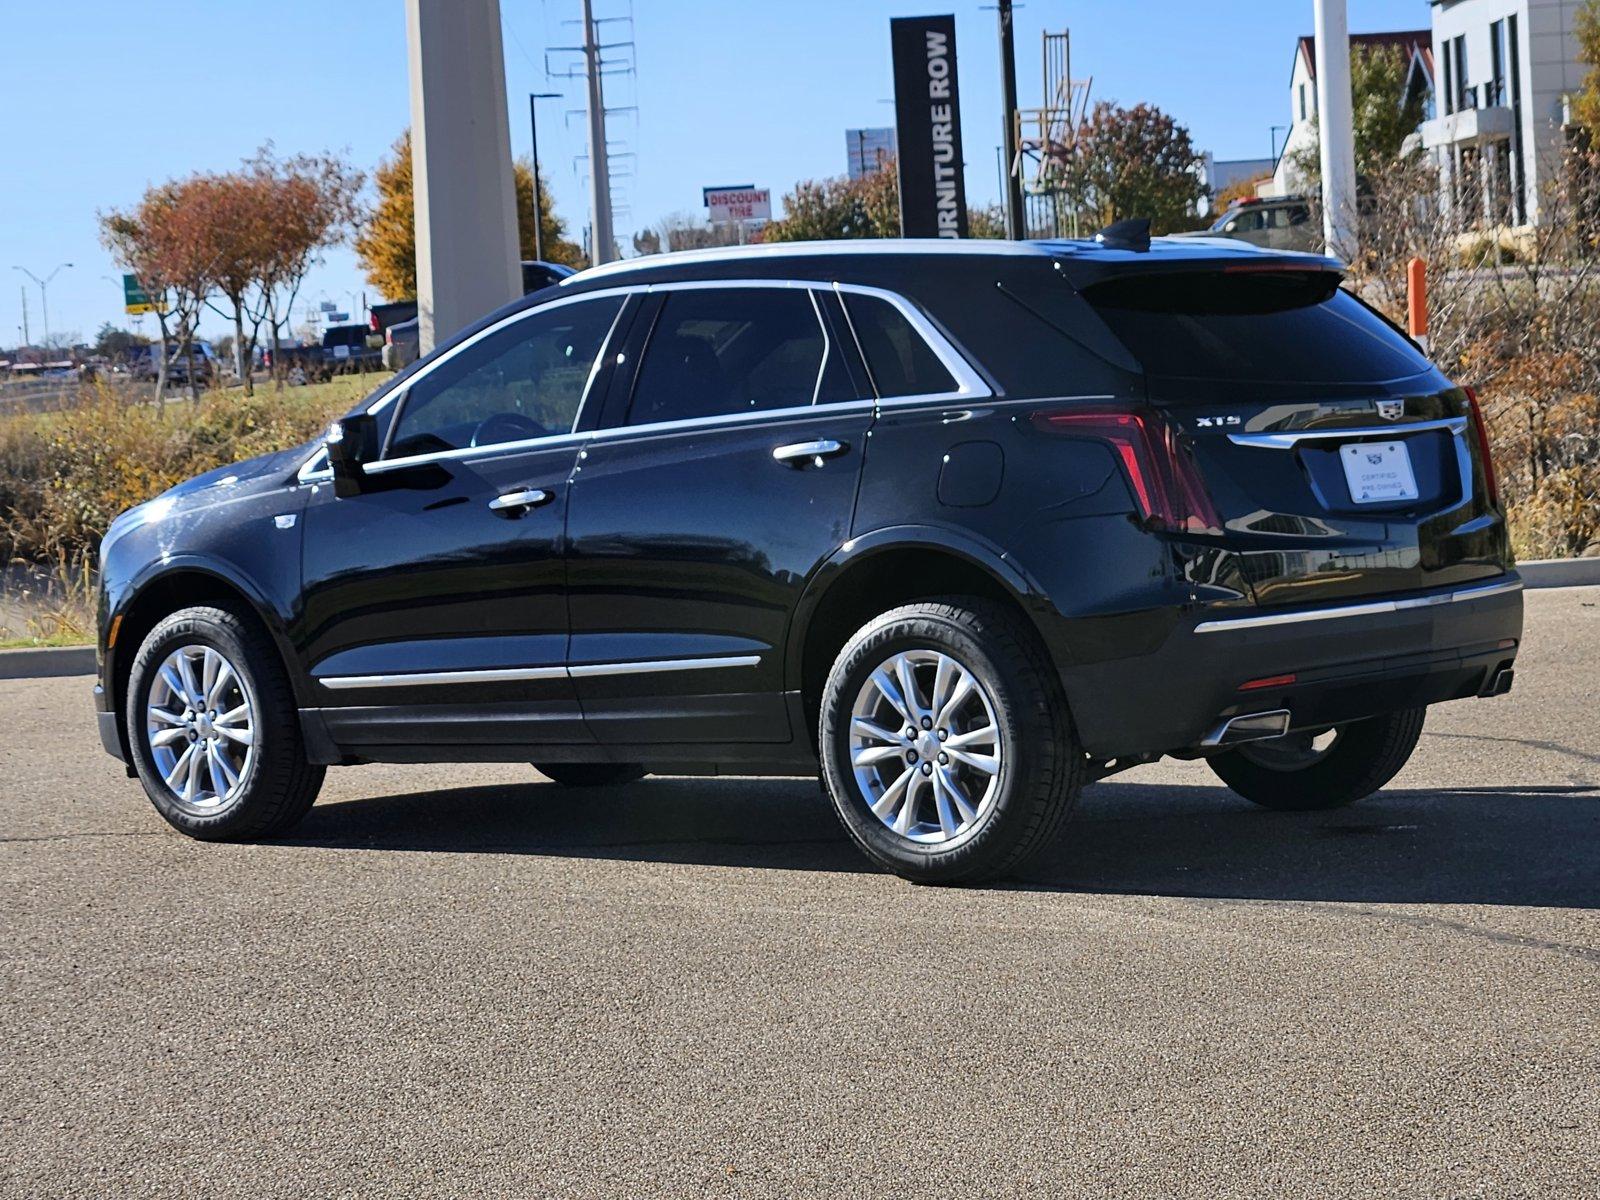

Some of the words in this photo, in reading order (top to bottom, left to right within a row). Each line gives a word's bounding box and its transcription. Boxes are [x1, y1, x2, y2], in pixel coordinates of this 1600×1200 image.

[926, 30, 950, 98] ROW
[931, 103, 959, 239] URNITURE
[711, 192, 767, 205] DISCOUNT
[729, 205, 753, 217] TIRE
[144, 623, 191, 667] IRONMAN
[844, 622, 915, 676] COUNTRY
